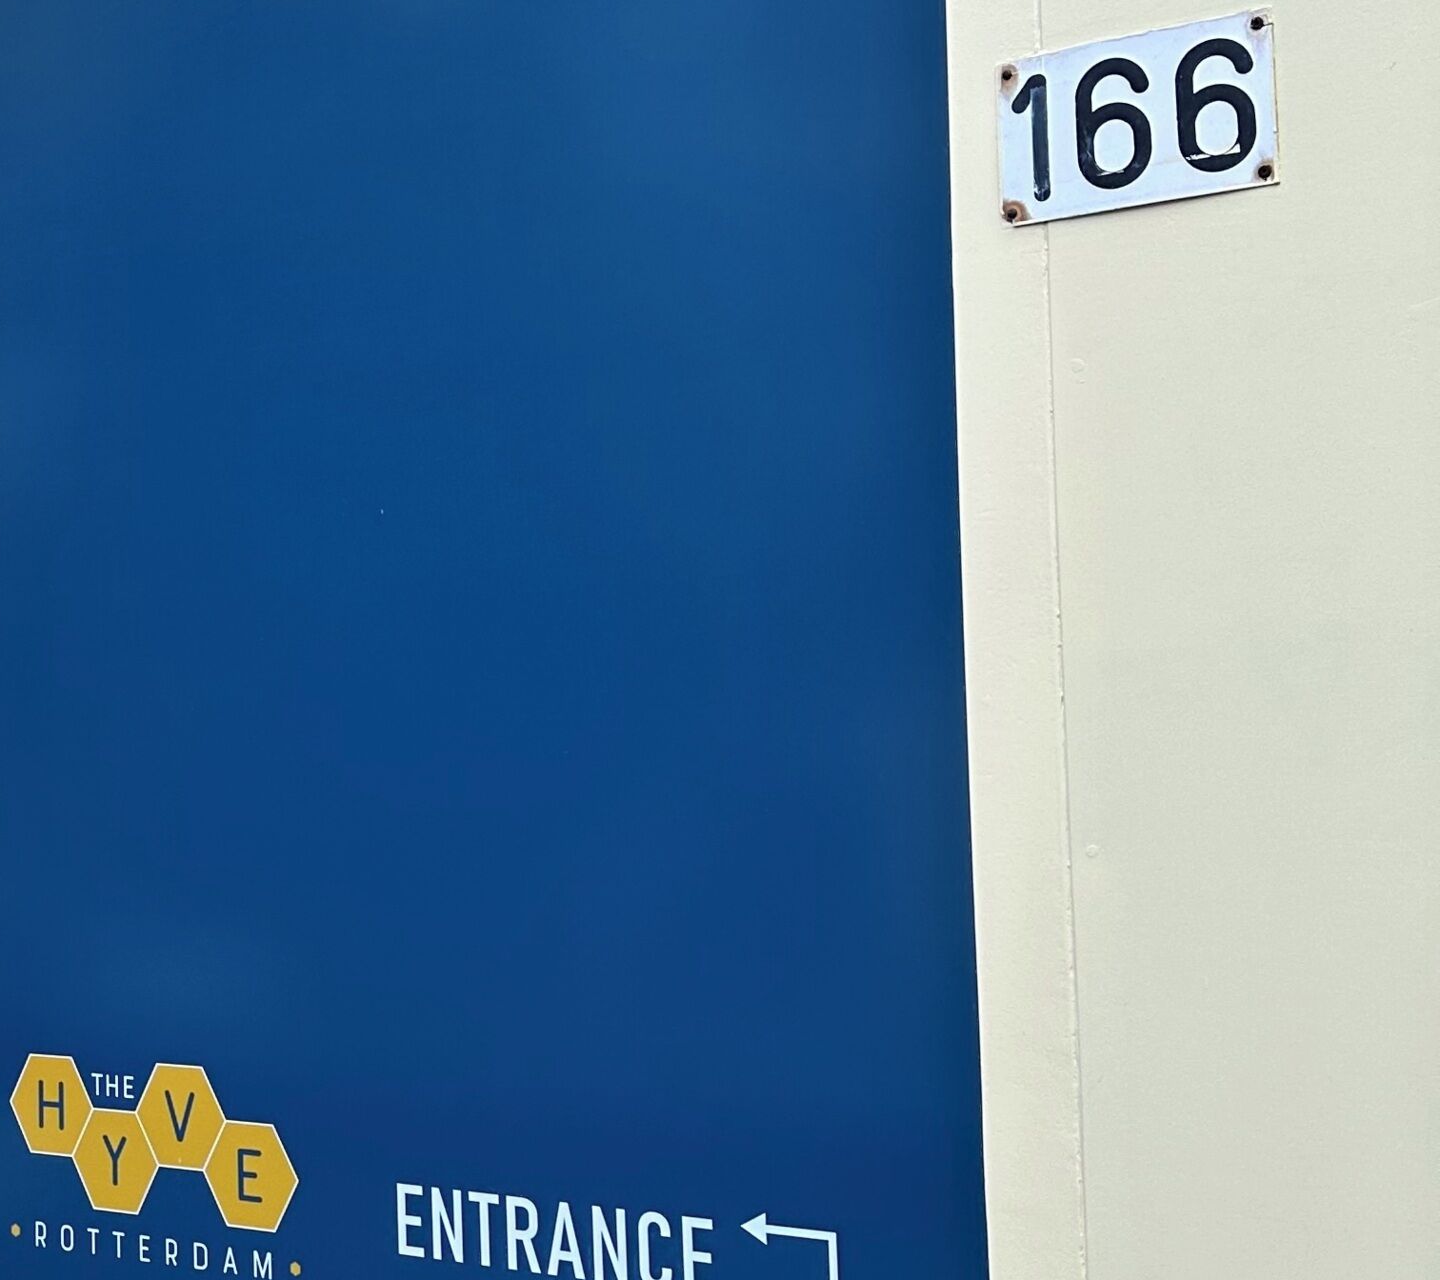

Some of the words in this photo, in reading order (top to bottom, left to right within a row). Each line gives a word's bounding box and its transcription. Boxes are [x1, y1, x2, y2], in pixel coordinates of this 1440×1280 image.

[1011, 38, 1257, 202] 166
[91, 1072, 134, 1099] THE
[38, 1080, 263, 1203] HYVE
[34, 1221, 273, 1280] ROTTERDAM
